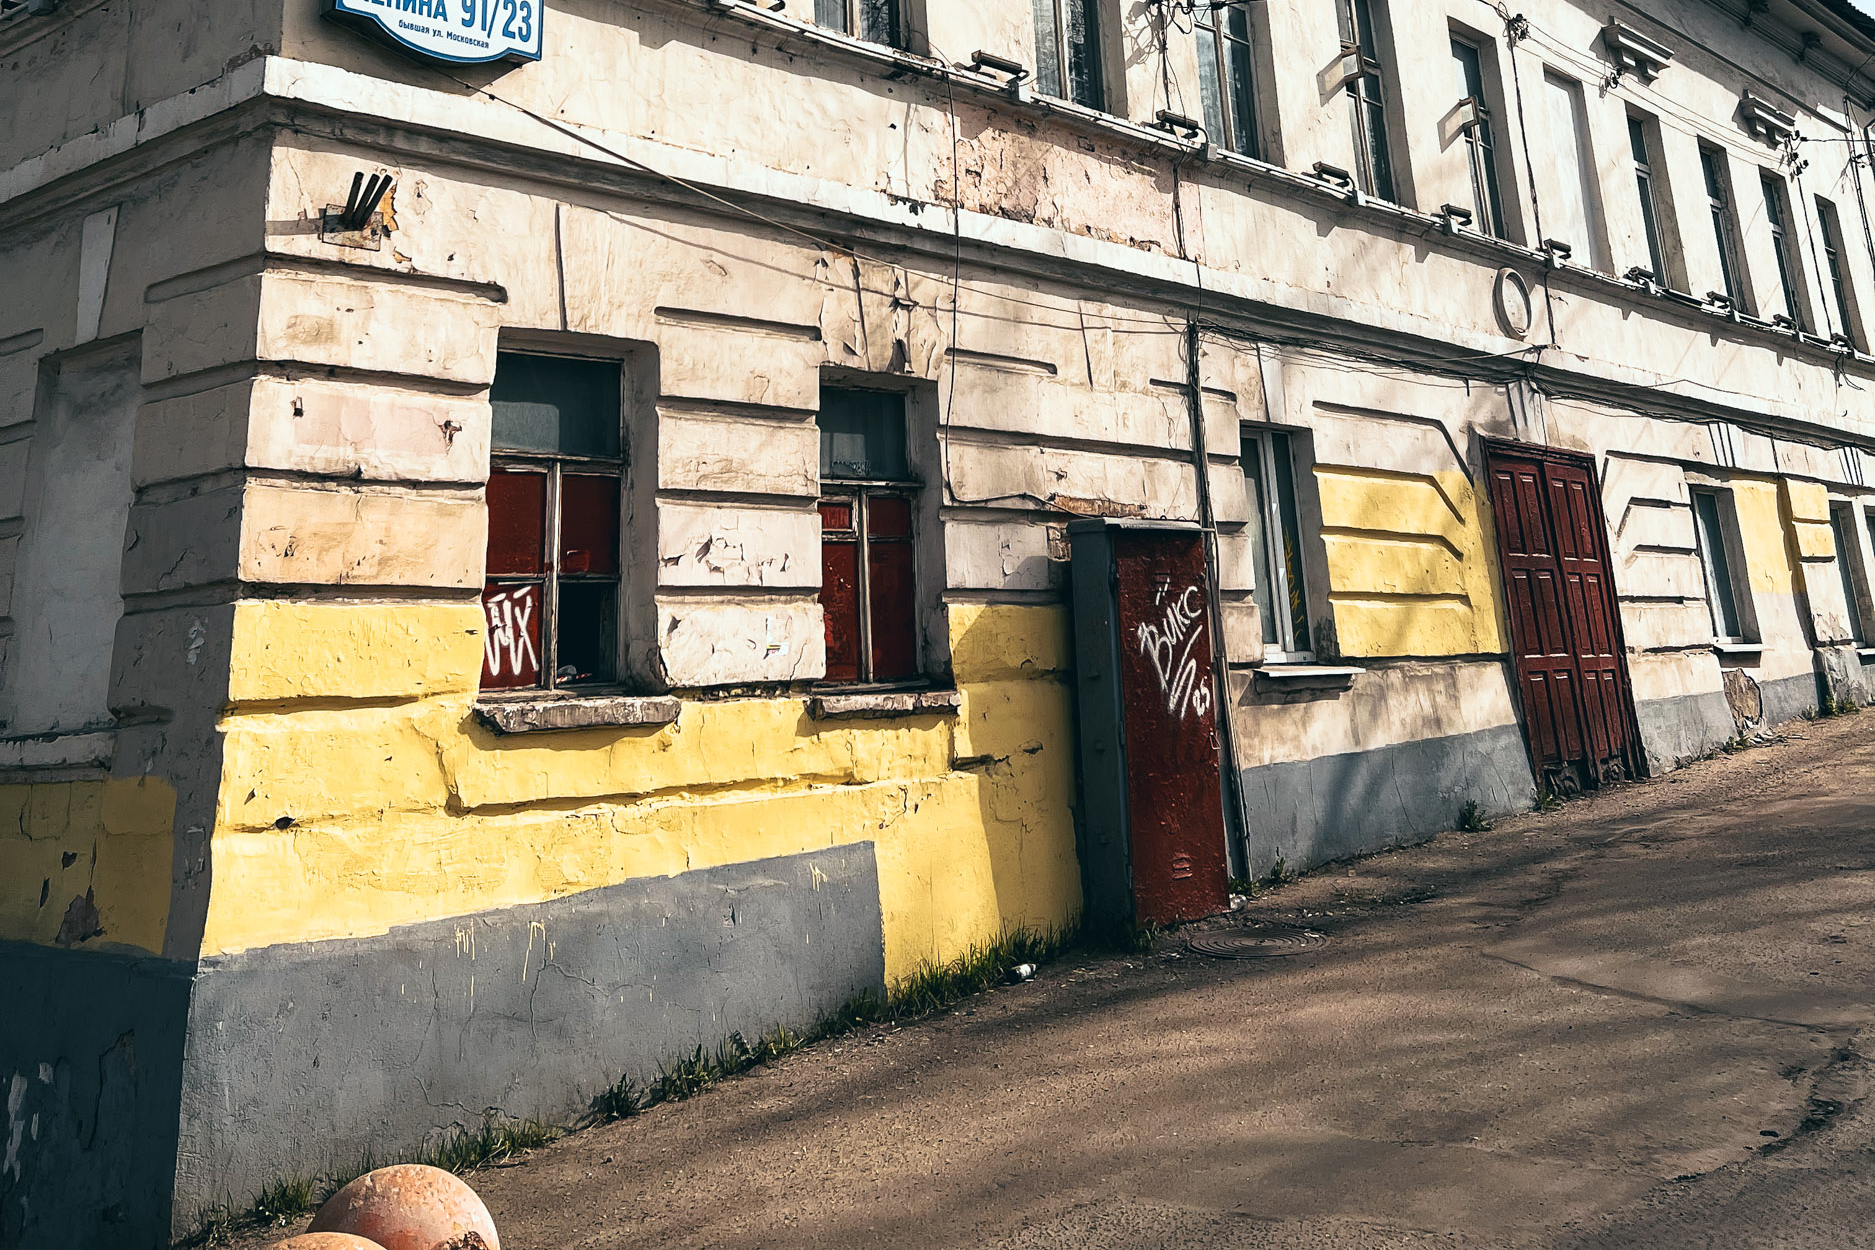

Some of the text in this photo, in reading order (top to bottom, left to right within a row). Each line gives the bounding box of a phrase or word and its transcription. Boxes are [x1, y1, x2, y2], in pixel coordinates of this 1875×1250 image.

[398, 19, 489, 49] бывшая ул. Московская
